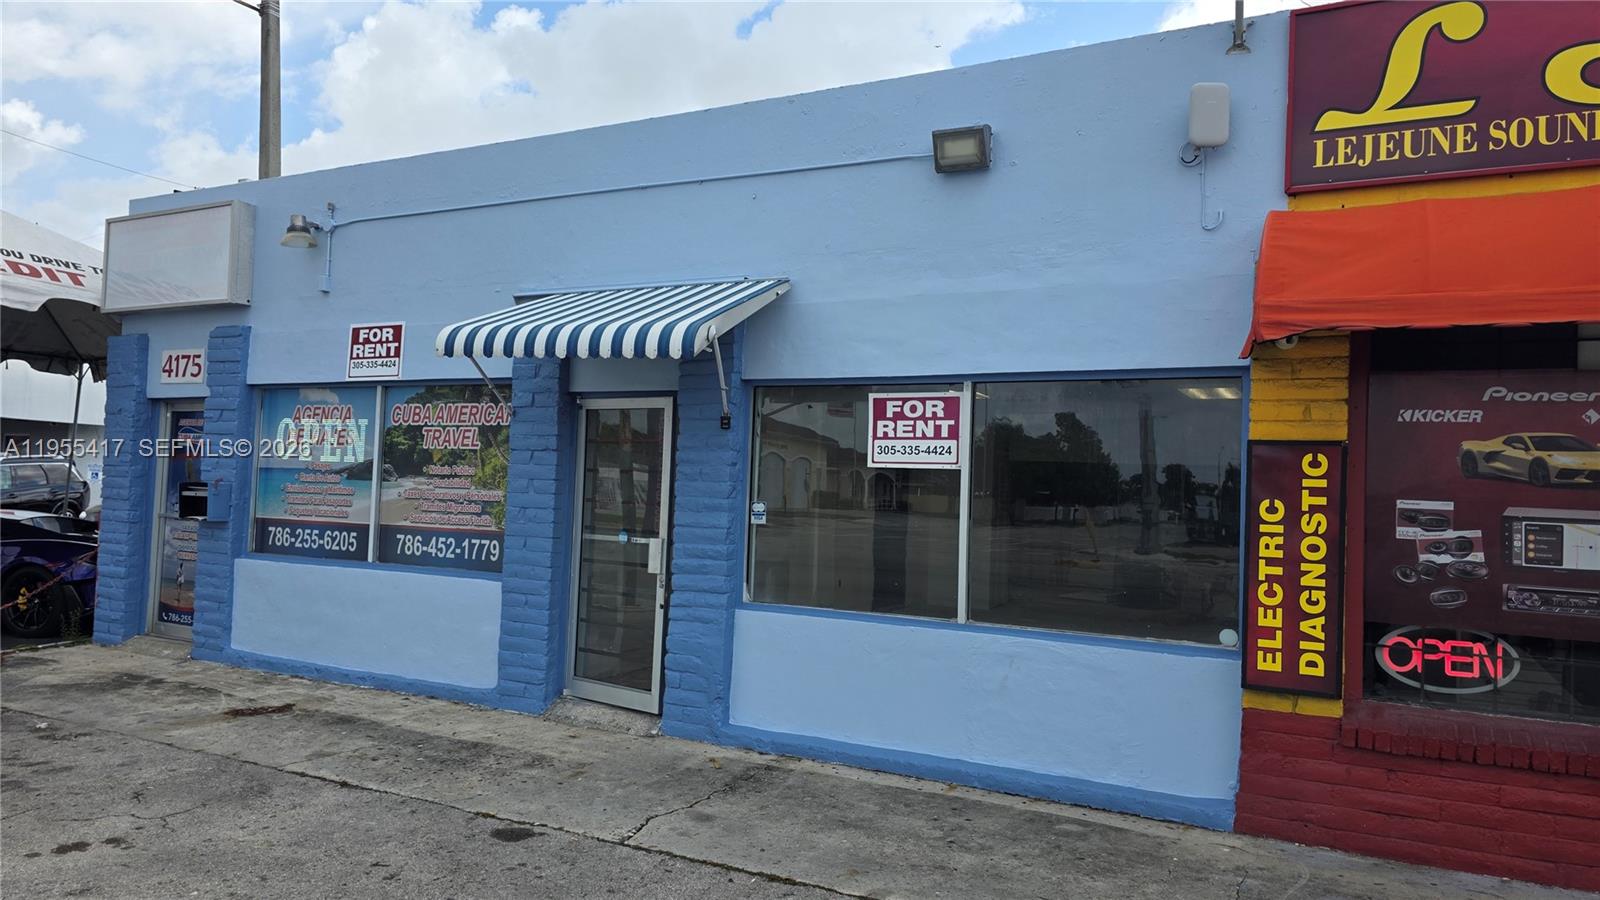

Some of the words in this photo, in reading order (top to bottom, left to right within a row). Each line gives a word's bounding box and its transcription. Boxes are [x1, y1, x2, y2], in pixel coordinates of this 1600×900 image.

[1313, 122, 1478, 168] LEJEUNE
[1488, 110, 1600, 151] SOUN
[0, 259, 86, 288] DIT
[29, 253, 86, 272] DRIVE
[358, 328, 394, 343] FOR
[352, 342, 399, 358] RENT
[161, 354, 202, 378] 4175
[351, 359, 397, 369] 305-335-4424
[1481, 386, 1600, 402] Pioneer
[292, 405, 354, 424] AGENCIA
[391, 404, 433, 426] CUBA
[885, 400, 945, 418] FOR
[1411, 409, 1484, 423] KICKER
[276, 418, 369, 462] OPEN
[422, 427, 481, 449] TRAVEL
[876, 420, 955, 438] RENT
[876, 445, 953, 456] 305-335-4424
[267, 526, 358, 552] 786-255-6205
[396, 534, 500, 562] 786-452-1779
[1299, 452, 1329, 677] DIAGNOSTIC
[1257, 498, 1285, 672] ELECTRIC
[1382, 635, 1504, 680] OPEN
